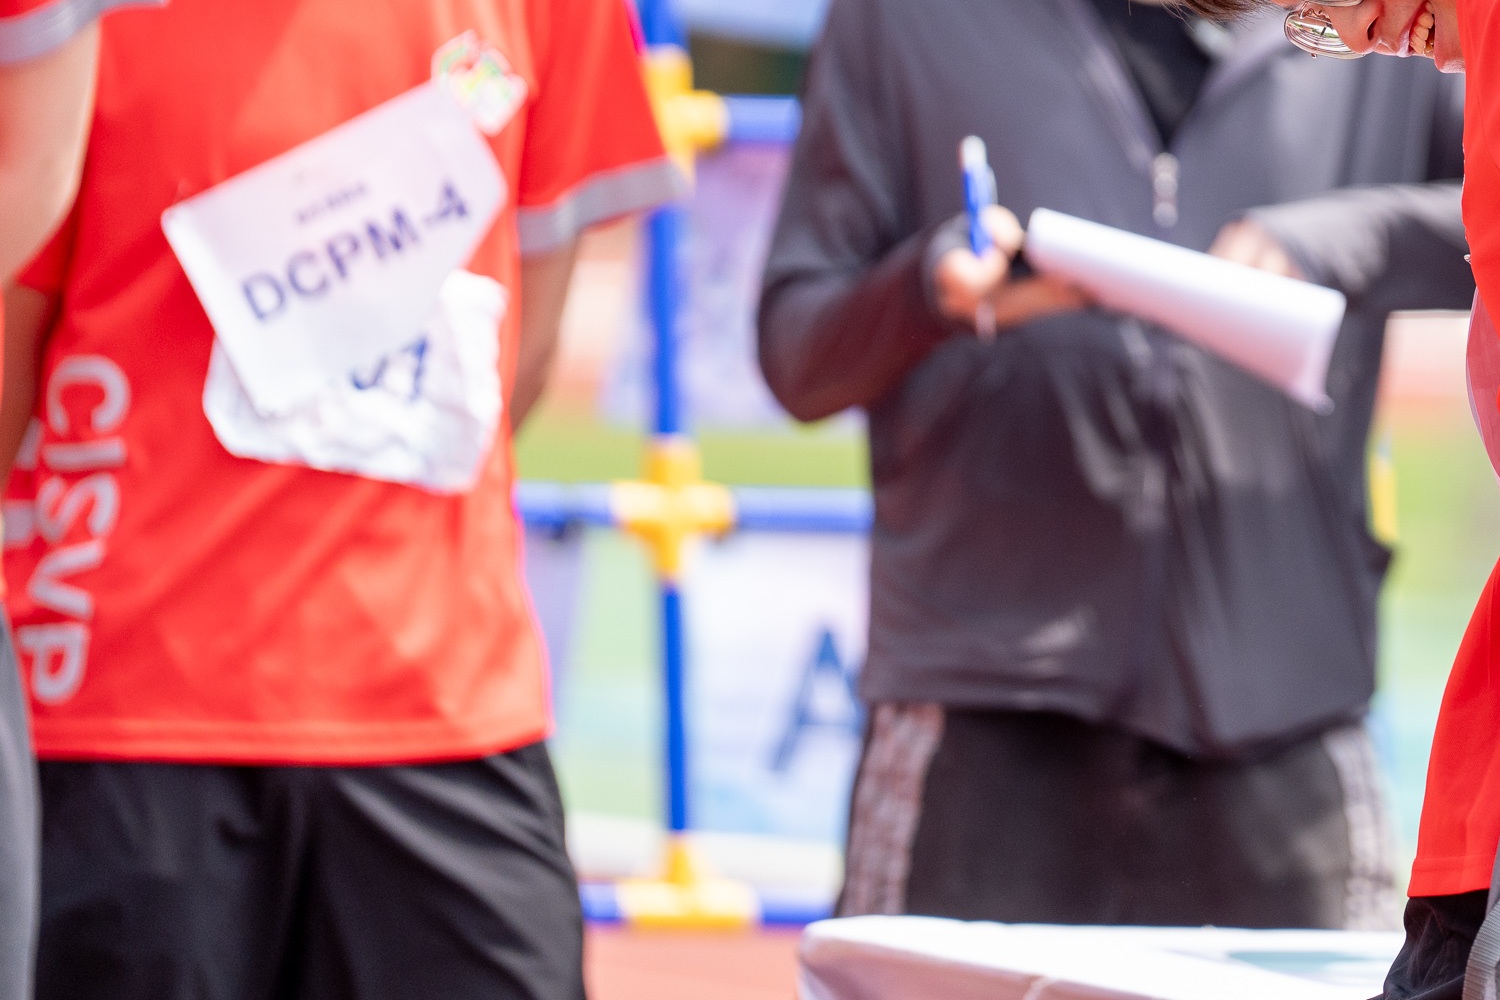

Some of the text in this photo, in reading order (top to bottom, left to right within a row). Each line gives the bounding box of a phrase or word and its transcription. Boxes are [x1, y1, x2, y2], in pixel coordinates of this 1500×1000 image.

[241, 178, 470, 323] DCPM-4
[18, 355, 131, 704] CISVP
[769, 624, 865, 773] A
